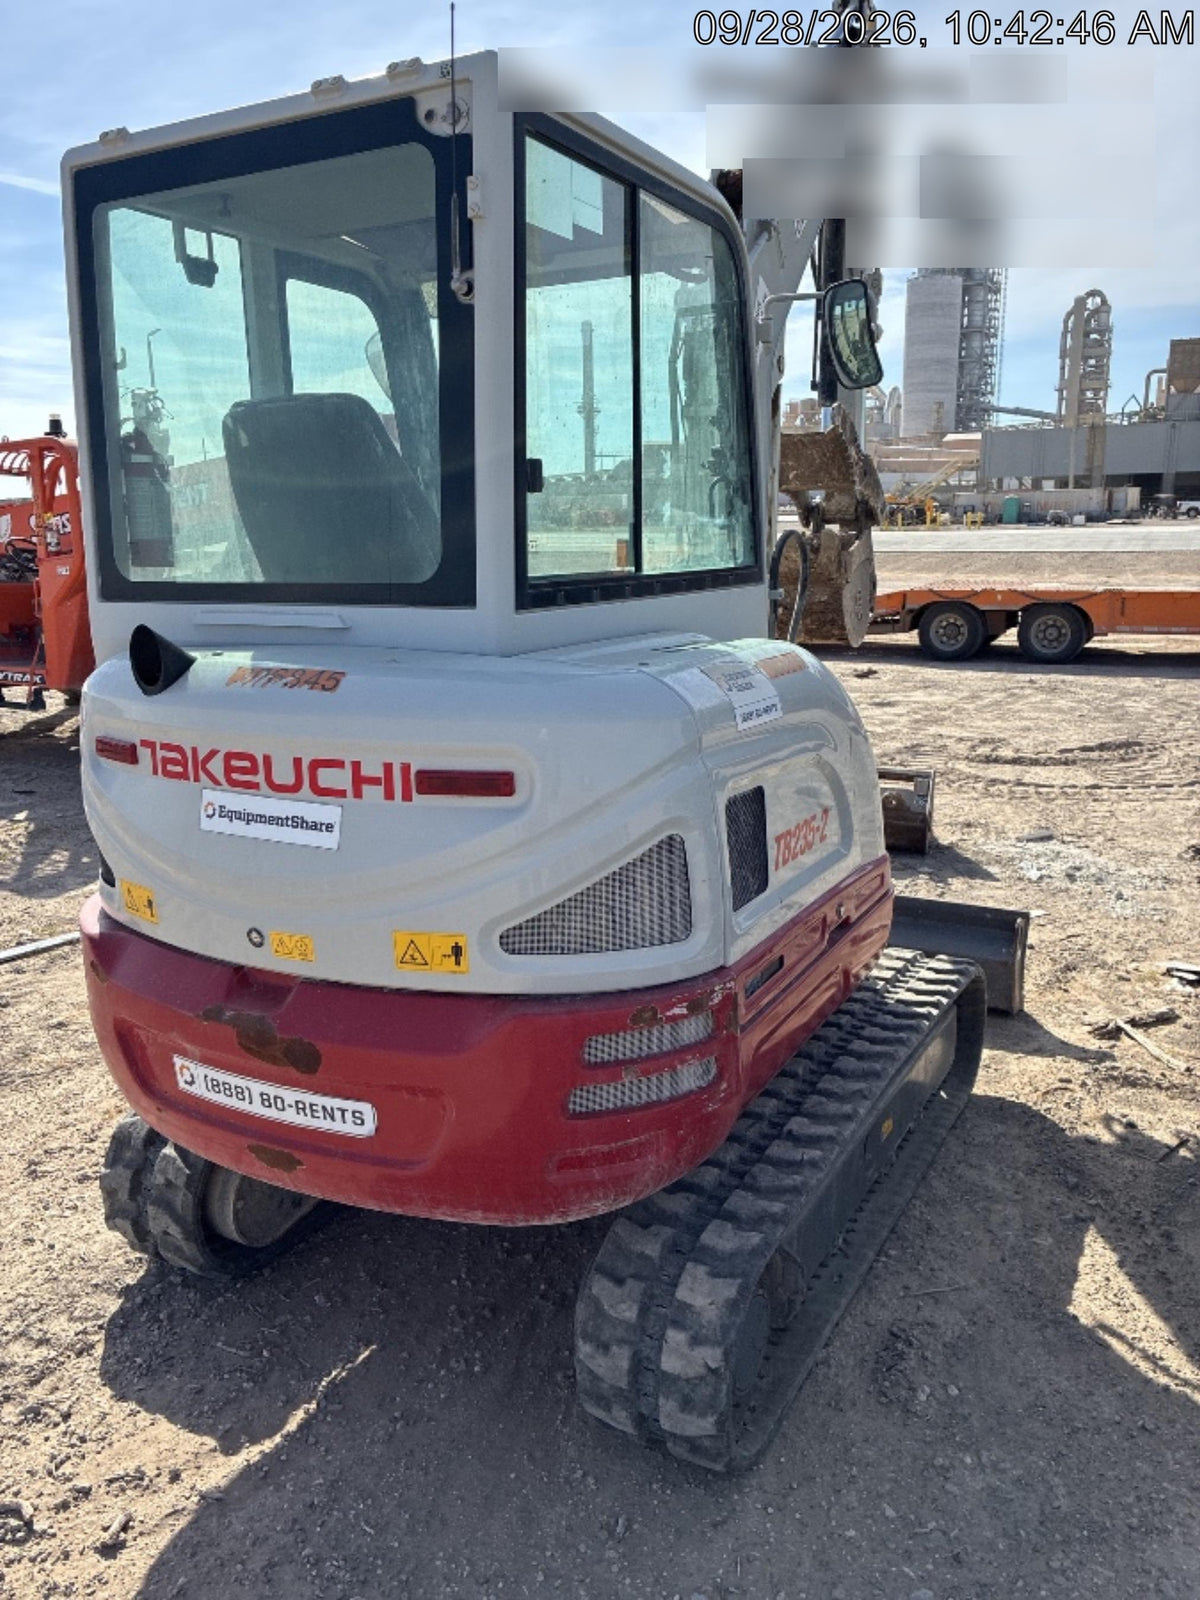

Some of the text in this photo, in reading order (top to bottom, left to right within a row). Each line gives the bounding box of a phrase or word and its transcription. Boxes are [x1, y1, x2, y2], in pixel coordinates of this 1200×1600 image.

[217, 804, 335, 834] EquipmentShare
[774, 806, 829, 872] TB235-2
[203, 1073, 366, 1127] (888) 80-RENTS
